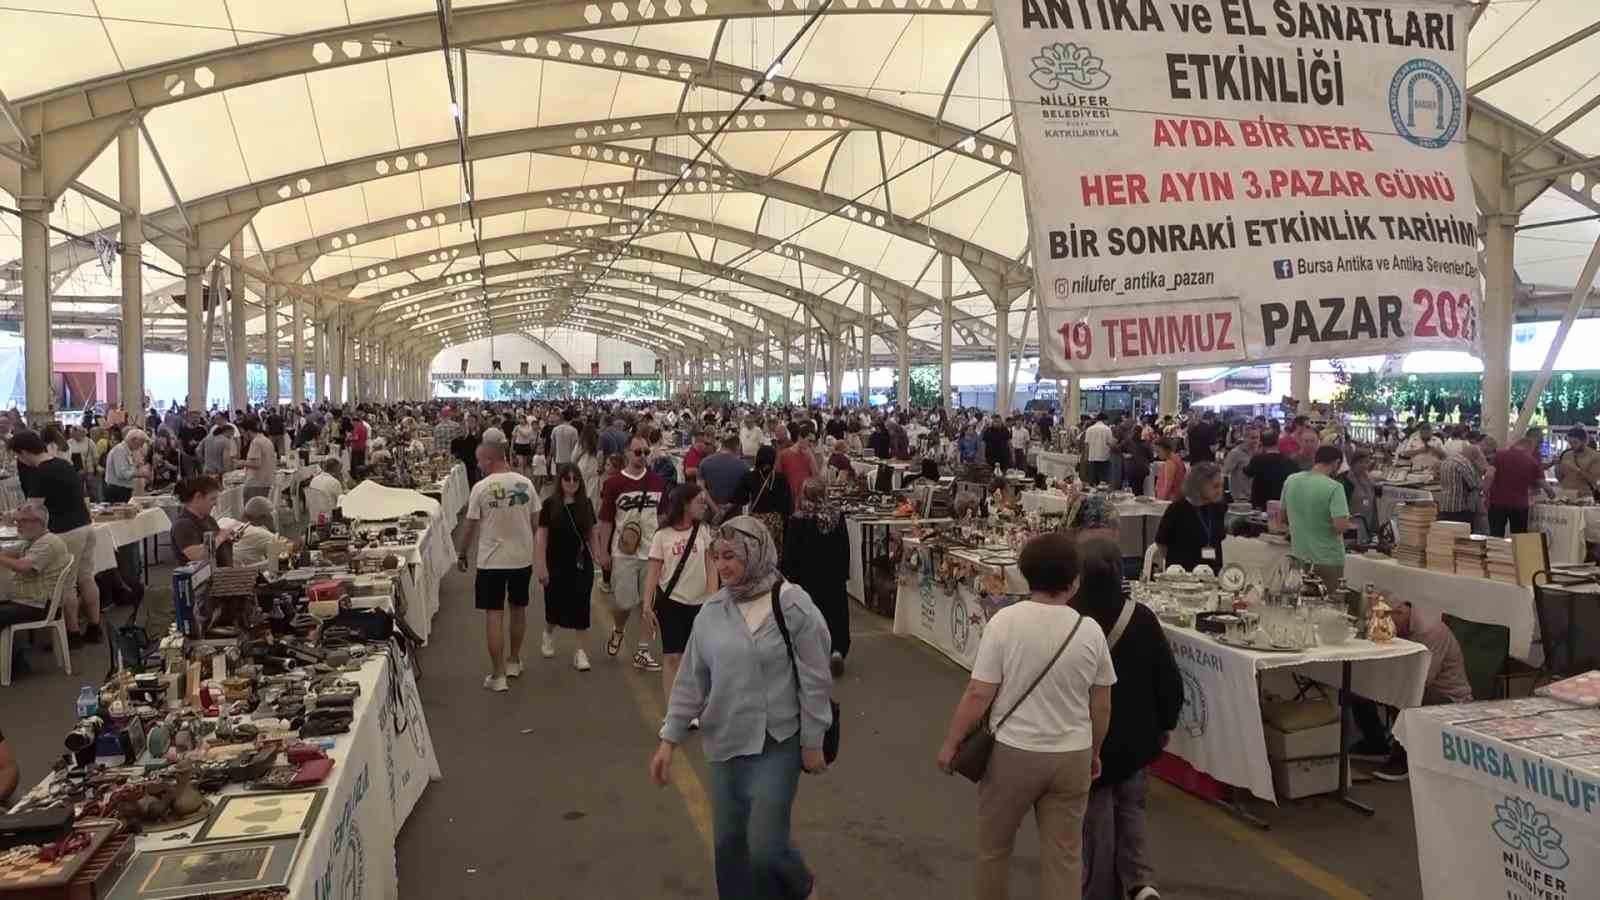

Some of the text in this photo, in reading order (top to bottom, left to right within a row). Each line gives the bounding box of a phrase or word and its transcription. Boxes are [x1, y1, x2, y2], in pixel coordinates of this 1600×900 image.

[1170, 3, 1213, 34] ve
[1220, 0, 1266, 36] EL
[1273, 0, 1455, 51] SANATLARI
[1040, 93, 1109, 106] NİLÜFER
[1166, 44, 1345, 106] ETKİNLİĞİ
[1042, 109, 1110, 119] BELEDİYESİ
[1153, 115, 1374, 152] AYDA BİR DEFA
[1080, 169, 1456, 207] HER AYIN 3.PAZAR GÜNÜ
[1048, 210, 1478, 260] BİR SONRAKİ ETKİNLİK TARİHİM
[1298, 258, 1334, 275] Bursa
[1337, 256, 1374, 272] Antika
[1376, 259, 1390, 271] ve
[1392, 256, 1423, 272] Antika
[1057, 311, 1235, 361] 19 TEMMUZ
[1260, 288, 1477, 346] PAZAR 202
[1441, 731, 1600, 814] BURSA NİLÜF
